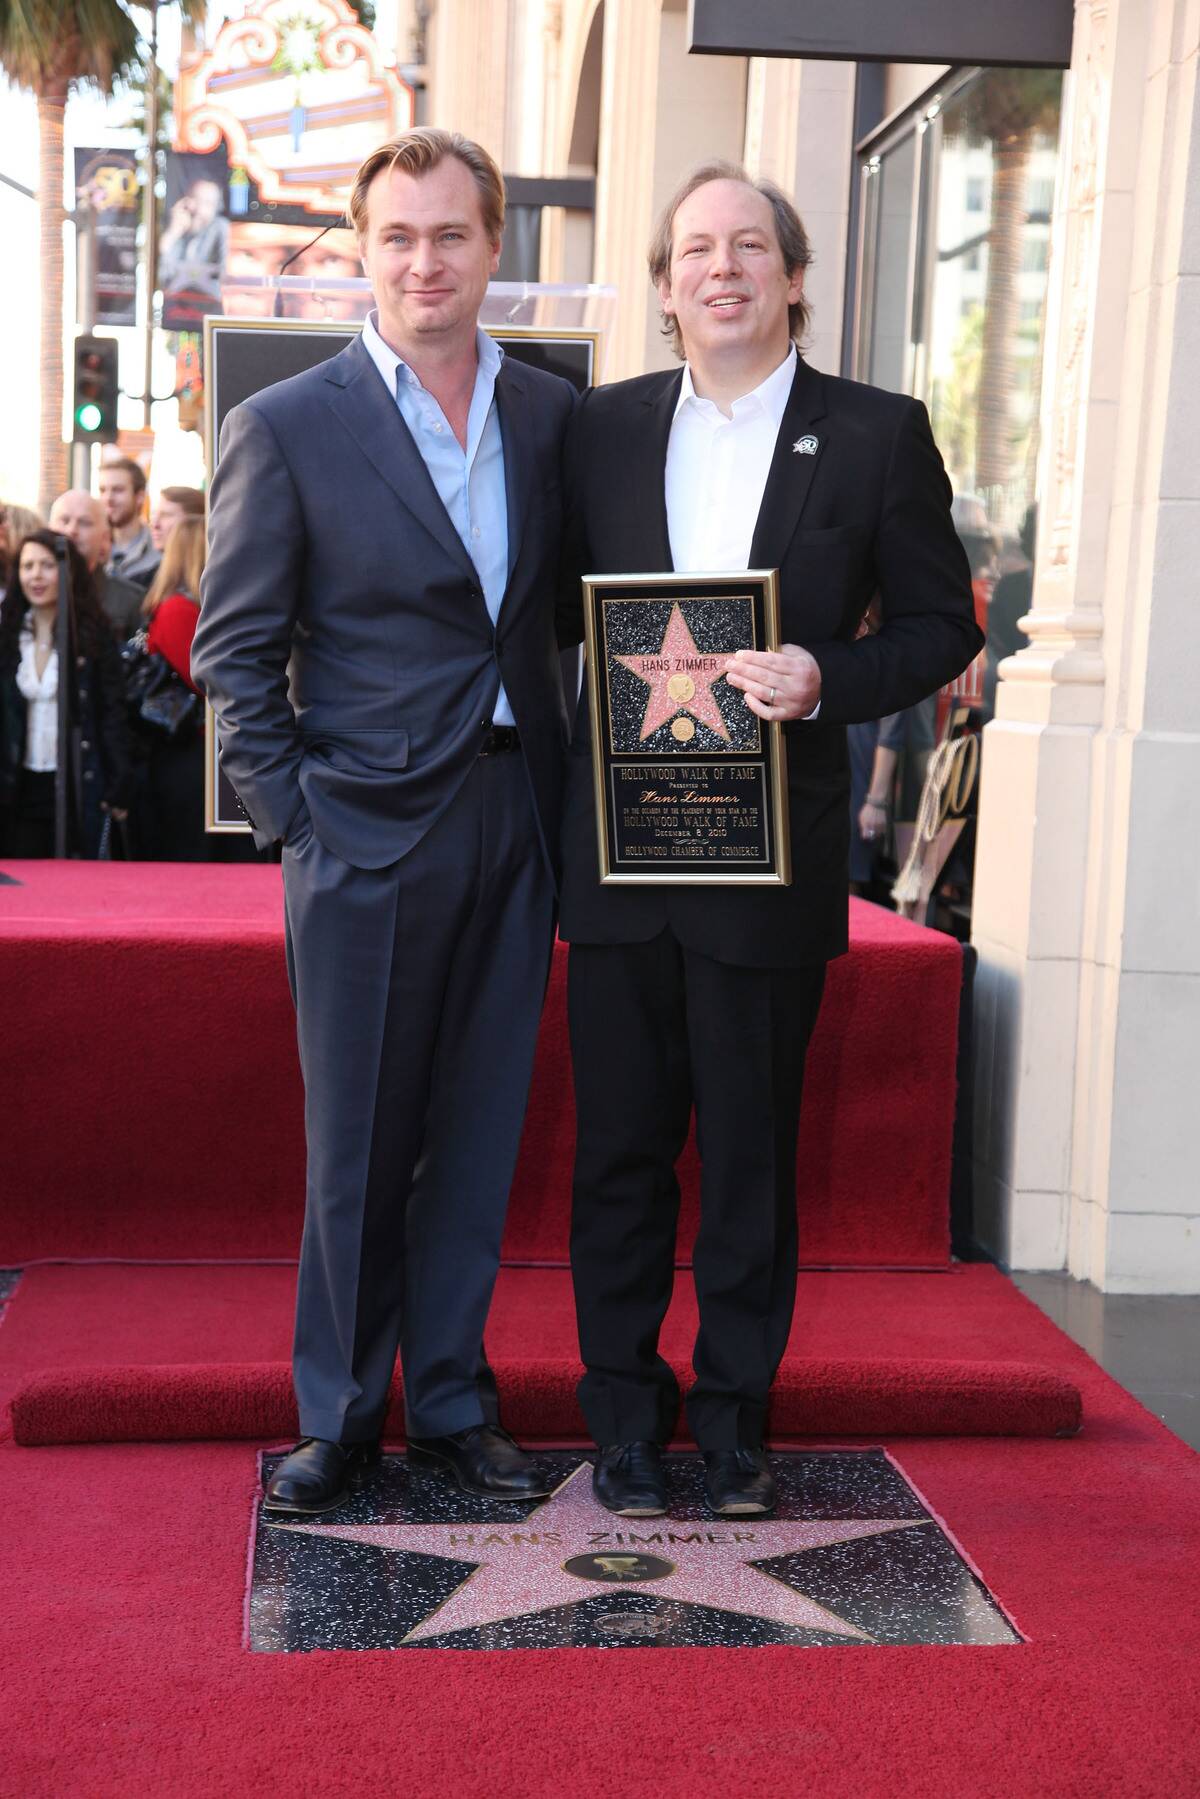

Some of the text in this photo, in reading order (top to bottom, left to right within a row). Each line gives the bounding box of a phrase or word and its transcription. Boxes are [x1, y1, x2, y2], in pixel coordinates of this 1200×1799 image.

[641, 658, 719, 672] HANS ZIMMER
[621, 768, 756, 780] HOLLYWOOD WALK OF FAME
[639, 790, 741, 803] Hans Zimmer
[624, 816, 758, 827] HOLLYWOOD WALK OF FAME
[708, 828, 727, 837] 2010
[625, 845, 760, 856] HOLLYWOOD CHAMBER OF COMMERCE
[450, 1531, 757, 1547] HANS ZIMMER
